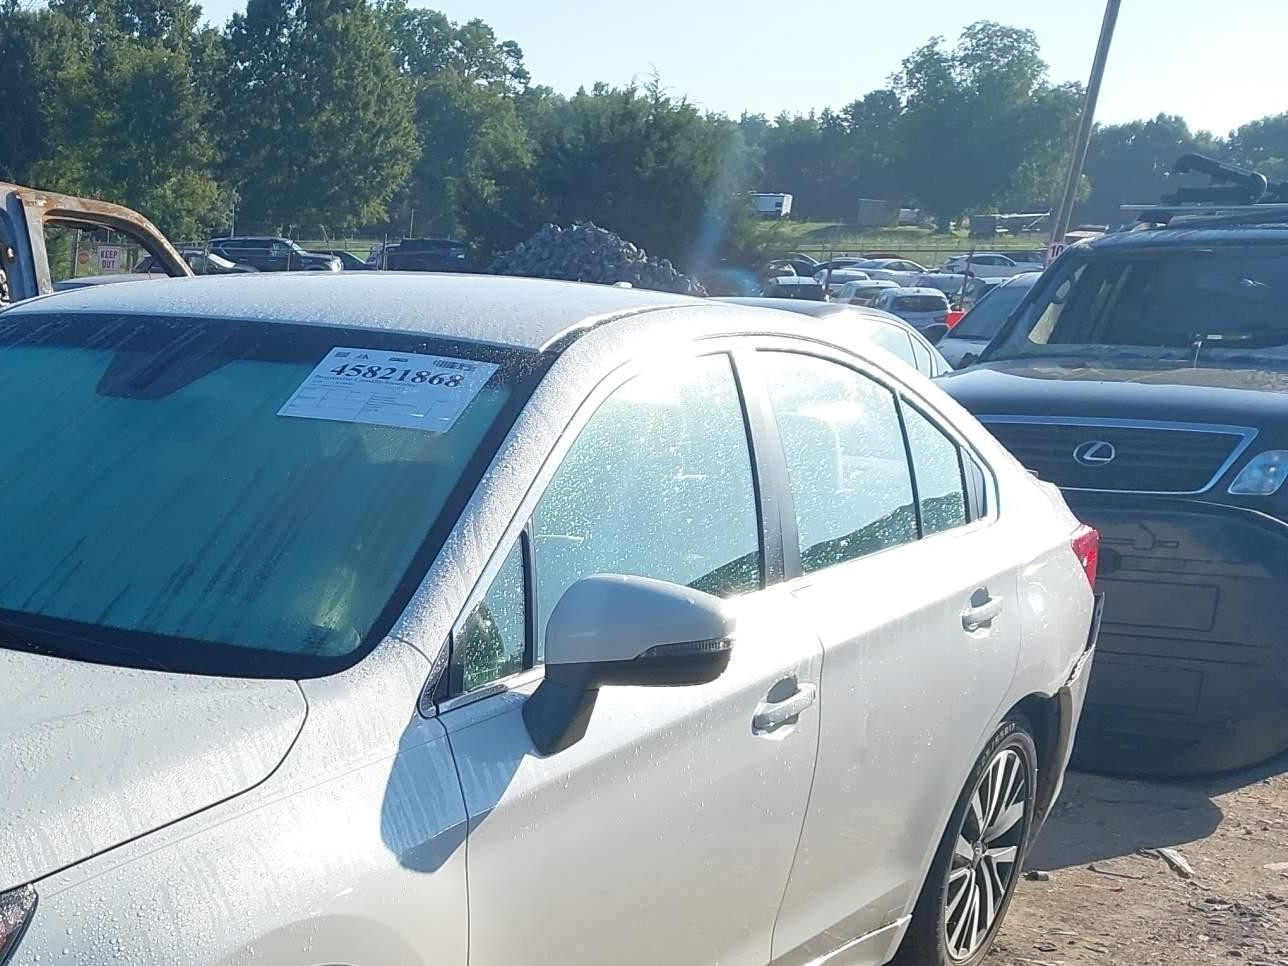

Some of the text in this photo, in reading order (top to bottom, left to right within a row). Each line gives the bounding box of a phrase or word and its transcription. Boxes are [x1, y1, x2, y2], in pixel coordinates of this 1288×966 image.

[100, 249, 118, 259] KEEP
[102, 260, 115, 269] OUT
[330, 362, 464, 388] 45821868
